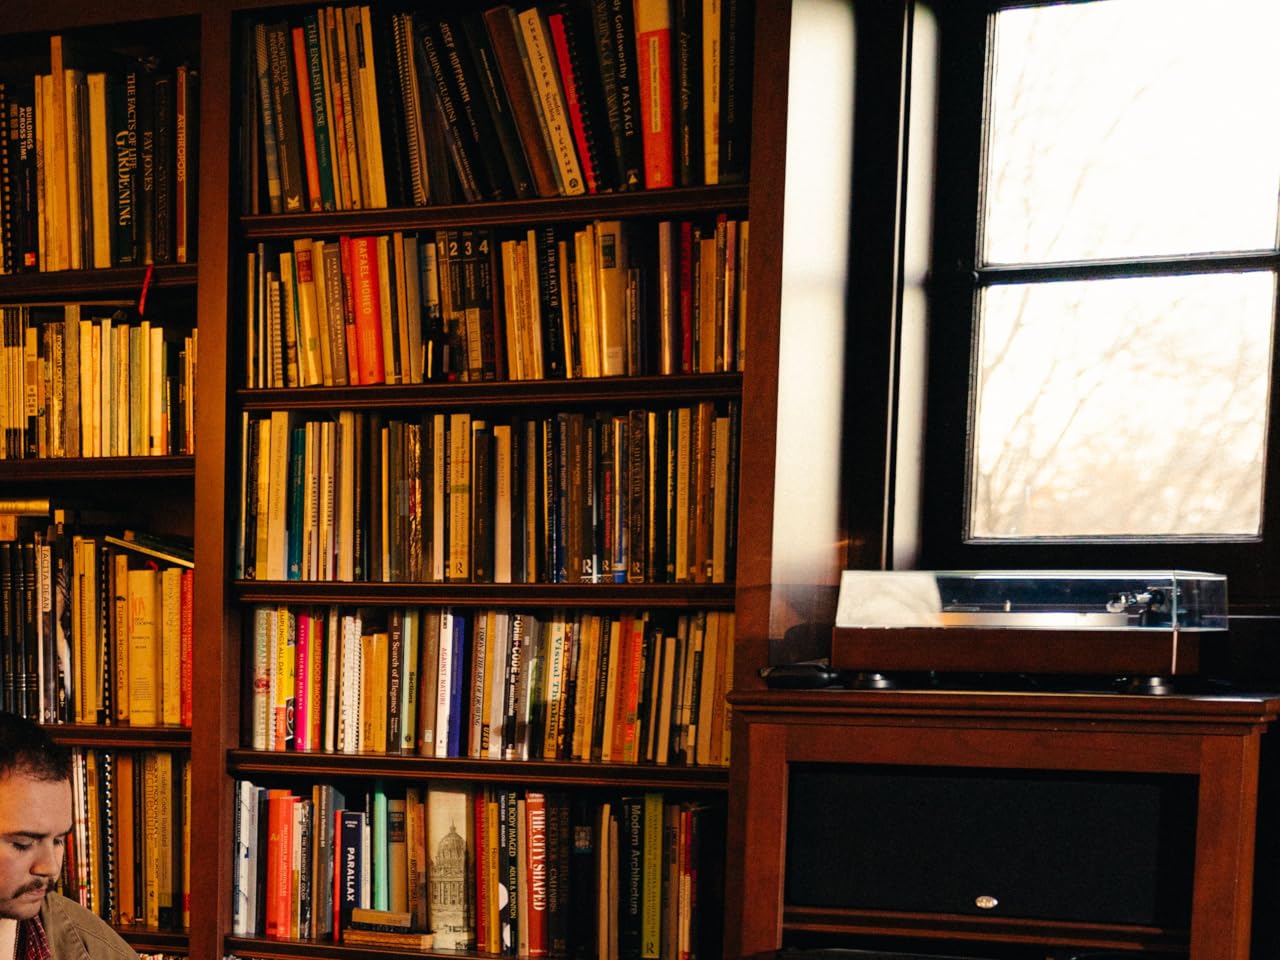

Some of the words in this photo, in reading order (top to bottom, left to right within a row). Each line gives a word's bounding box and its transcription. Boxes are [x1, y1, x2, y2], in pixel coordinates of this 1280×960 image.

[307, 23, 317, 47] THE
[613, 14, 630, 79] Goldsworthy
[269, 32, 280, 82] INVENTIONS
[277, 31, 290, 96] ARCHITECTURAL
[309, 47, 321, 90] ENGLISH
[439, 22, 454, 49] JOSEF
[449, 51, 471, 103] HOFFMANN
[127, 73, 136, 97] THE
[423, 36, 444, 81] GUARINO
[437, 81, 457, 123] GUARINI
[127, 98, 136, 130] FACTS
[313, 91, 325, 127] HOUSE
[621, 85, 634, 138] PASSAGE
[25, 106, 33, 150] BUILDINGS
[128, 131, 136, 146] OF
[144, 131, 153, 151] FAY
[177, 114, 185, 183] ARTHROPODS
[115, 130, 132, 226] GARDENING
[141, 153, 153, 192] JONES
[358, 240, 370, 278] RAFAEL
[449, 241, 458, 257] 2
[464, 241, 472, 256] 3
[479, 239, 488, 254] 4
[360, 280, 372, 315] MONEO
[42, 549, 50, 580] TACITA
[42, 583, 50, 610] DEAN
[392, 631, 401, 640] In
[510, 615, 524, 674] FORM+CODE
[313, 639, 322, 681] SUPERFOOD
[392, 641, 400, 667] Search
[440, 647, 448, 676] AGAINST
[552, 636, 562, 677] Visual
[392, 668, 400, 678] of
[313, 683, 322, 725] SMOOTHIES
[390, 679, 400, 714] Elegance
[439, 679, 447, 706] NATURE
[547, 680, 561, 740] Thinking
[160, 796, 168, 816] Codes
[508, 791, 516, 806] THE
[160, 817, 168, 847] Illustrated
[508, 807, 517, 827] BODY
[532, 808, 546, 833] THE
[630, 804, 641, 846] Modern
[508, 828, 517, 857] IMAGED
[532, 834, 546, 862] CITY
[346, 847, 356, 902] PARALLAX
[509, 865, 517, 884] ADLER
[532, 863, 547, 911] SHAPED
[630, 849, 641, 916] Architecture
[509, 891, 517, 919] POINTON
